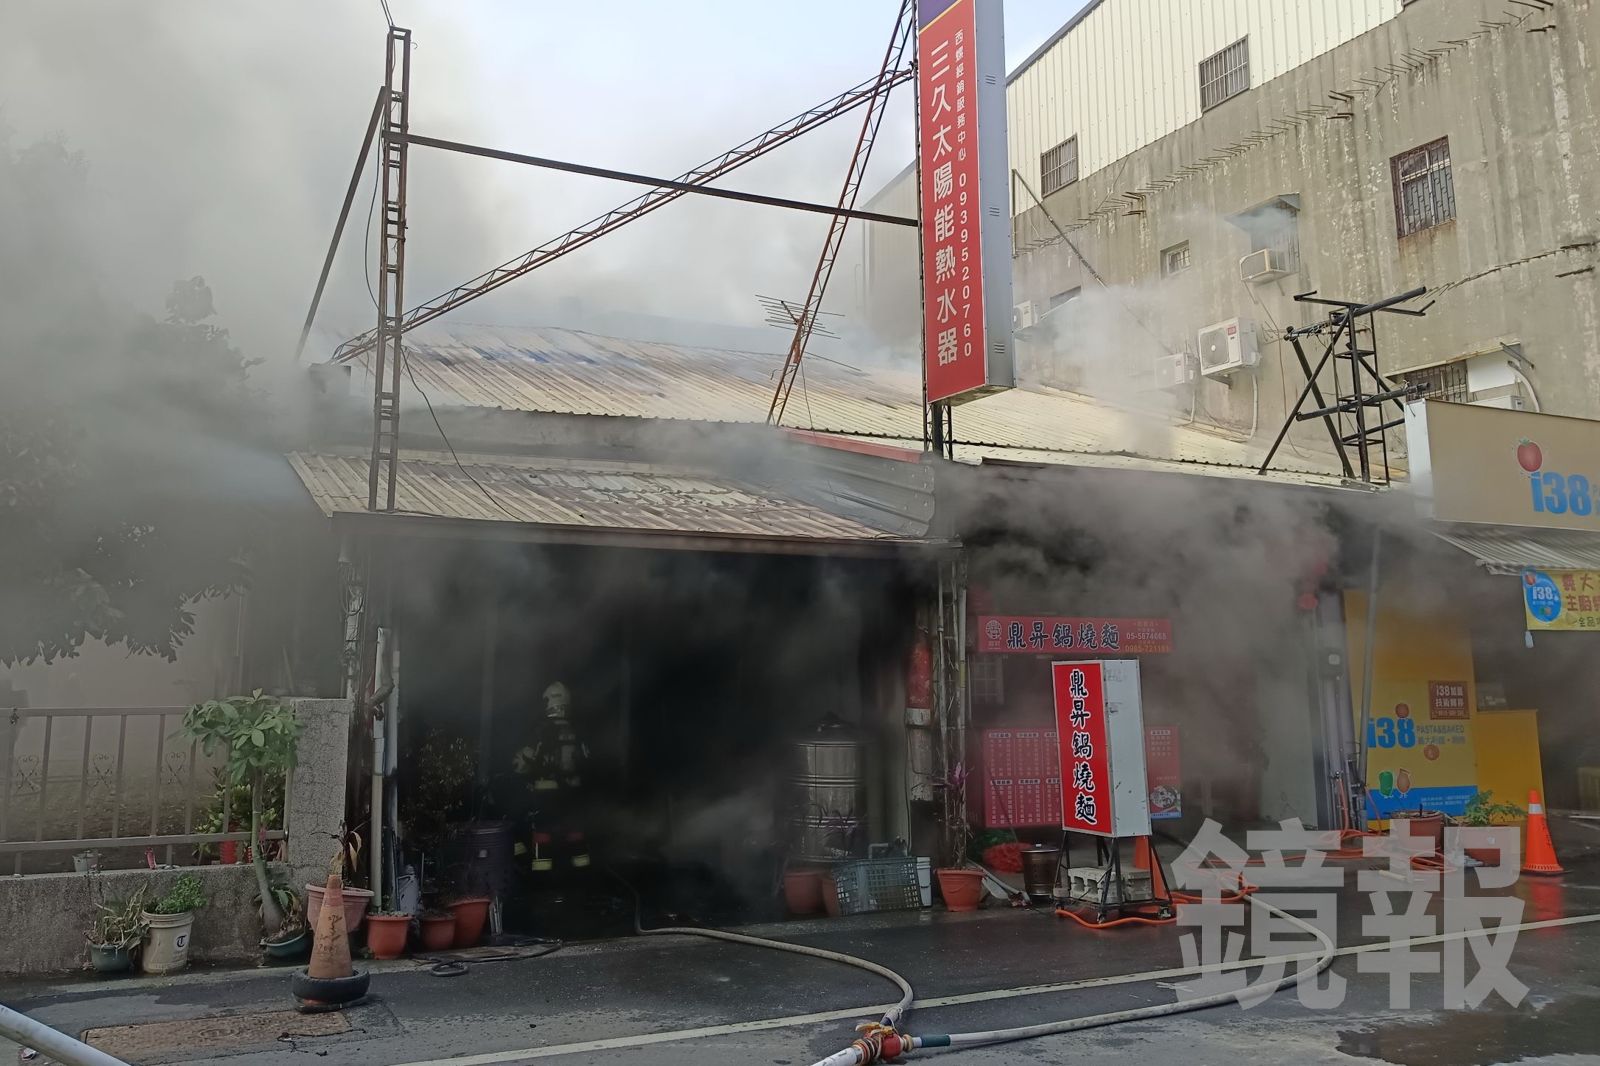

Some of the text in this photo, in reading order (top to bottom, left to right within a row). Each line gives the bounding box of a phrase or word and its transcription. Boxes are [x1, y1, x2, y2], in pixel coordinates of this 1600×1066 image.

[931, 40, 958, 366] 三久太陽能熱水器
[959, 172, 972, 357] 0939520760
[1530, 471, 1592, 516] i38
[1532, 586, 1554, 600] i38
[1368, 717, 1416, 749] i38
